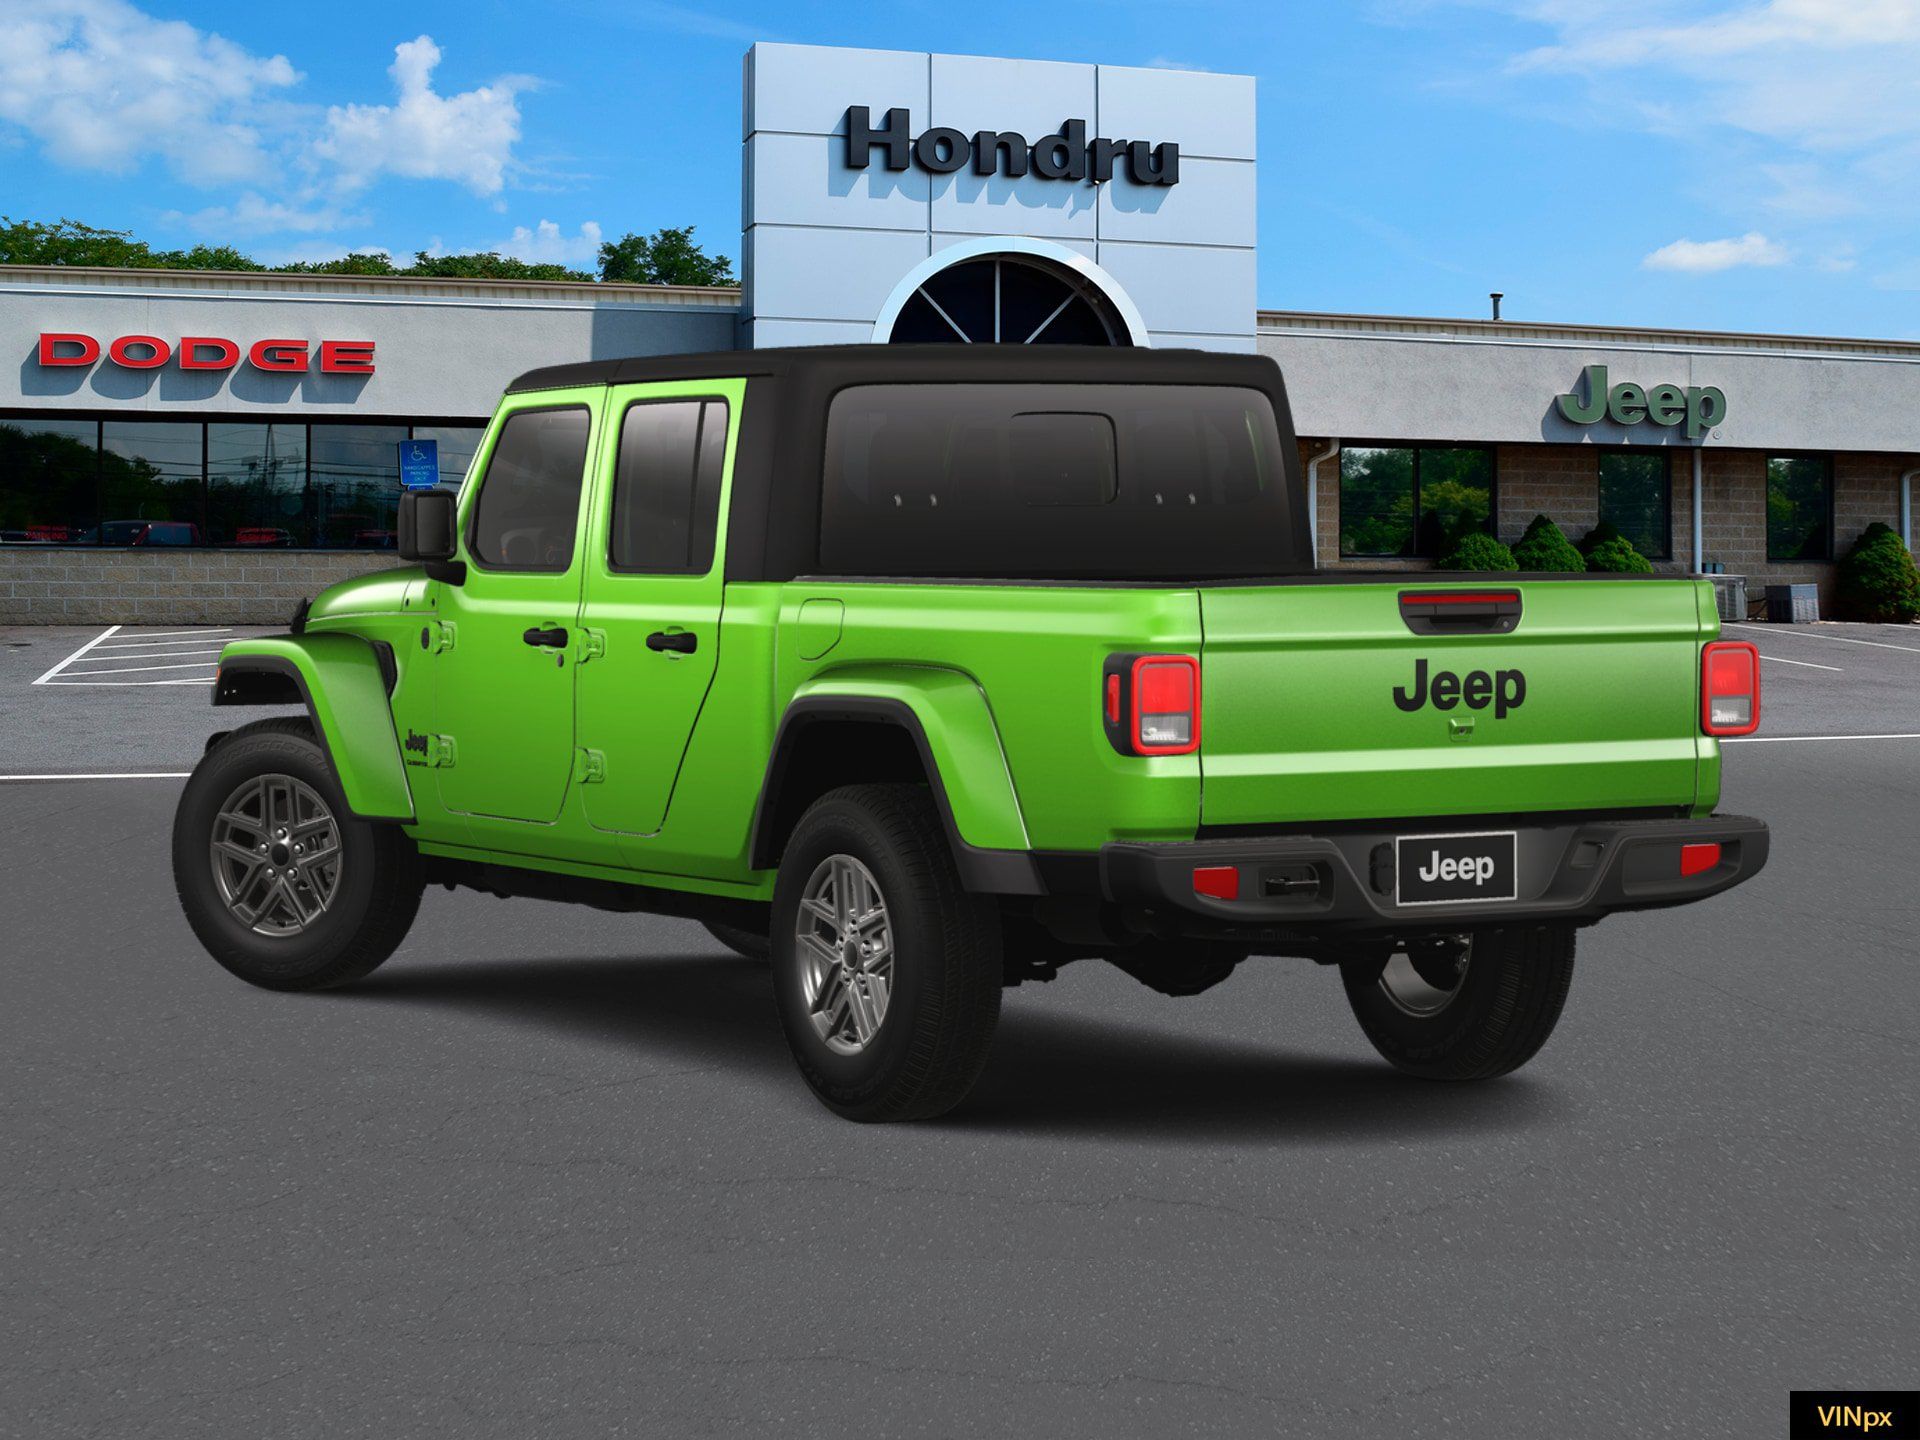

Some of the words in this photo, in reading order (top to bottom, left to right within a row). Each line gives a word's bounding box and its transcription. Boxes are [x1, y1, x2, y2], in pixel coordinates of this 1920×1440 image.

[847, 105, 1179, 185] Hondru
[39, 333, 376, 373] DODGE
[1556, 365, 1727, 438] Jeep
[1393, 658, 1527, 719] Jeep
[1419, 850, 1495, 886] Jeep
